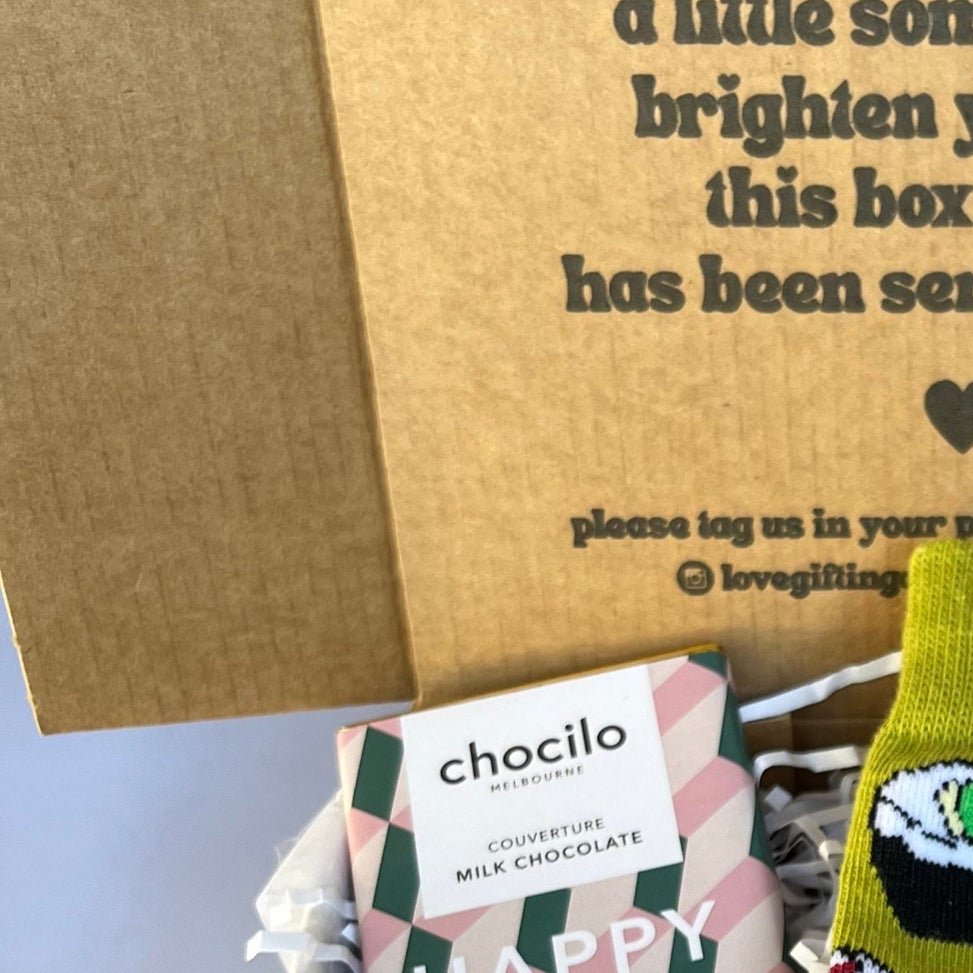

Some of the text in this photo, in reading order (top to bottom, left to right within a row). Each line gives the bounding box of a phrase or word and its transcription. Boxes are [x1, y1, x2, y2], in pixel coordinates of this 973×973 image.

[613, 0, 658, 45] a
[673, 0, 835, 46] little
[631, 73, 939, 158] brighten
[705, 166, 838, 228] this
[561, 254, 686, 313] has
[698, 254, 866, 313] been
[571, 508, 691, 548] please
[698, 511, 754, 548] tag
[761, 516, 804, 539] us
[812, 507, 851, 539] in
[858, 515, 948, 547] your
[440, 717, 627, 785] chocilo
[490, 765, 584, 793] MELBOURNE
[456, 830, 644, 883] MILK CHOCOLATE
[488, 818, 605, 853] COUVERTURE
